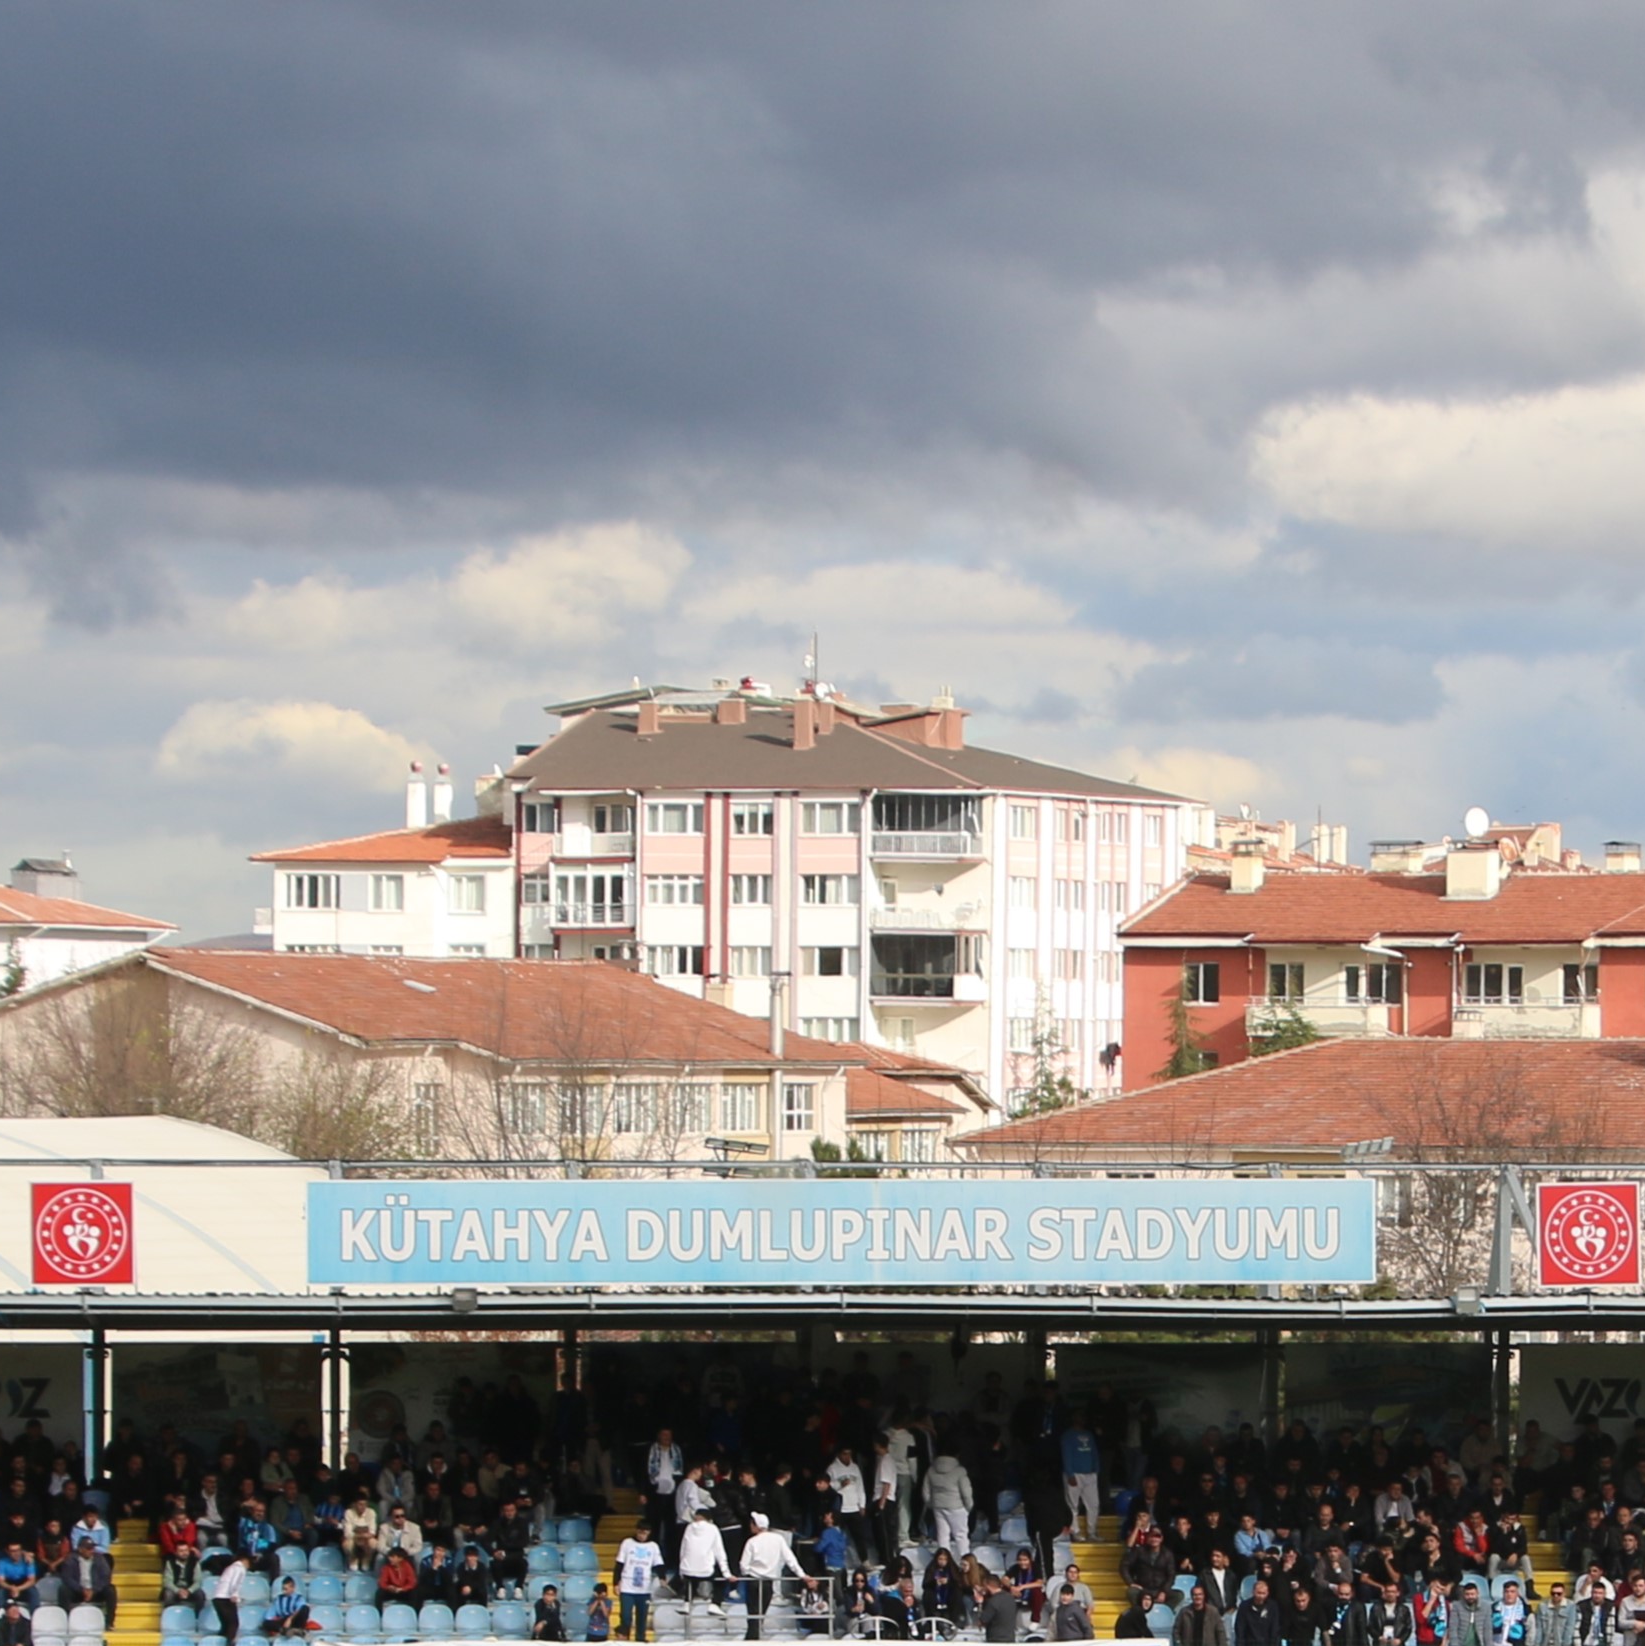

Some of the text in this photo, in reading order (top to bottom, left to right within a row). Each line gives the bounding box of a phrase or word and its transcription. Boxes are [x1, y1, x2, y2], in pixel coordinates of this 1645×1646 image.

[338, 1193, 1342, 1261] KÜTAHYA DUMLUPINAR STADYUMU
